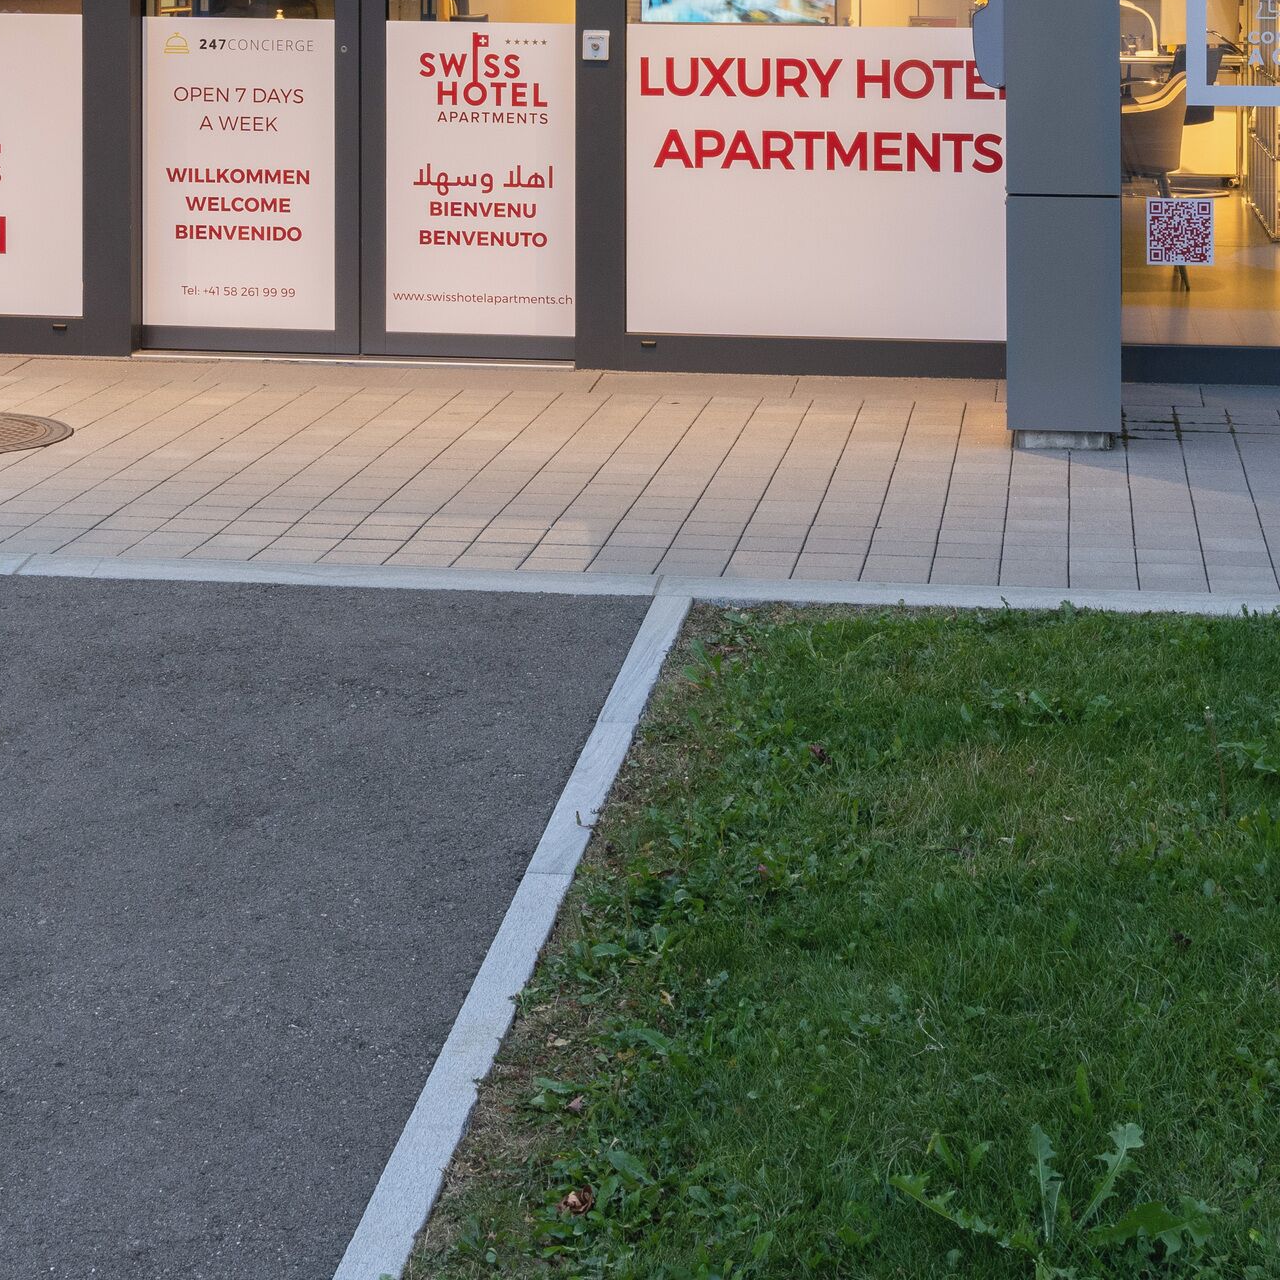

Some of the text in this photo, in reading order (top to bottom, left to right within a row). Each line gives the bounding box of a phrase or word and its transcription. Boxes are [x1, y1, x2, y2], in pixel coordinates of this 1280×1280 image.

[199, 38, 314, 52] 247CONCIERGE
[419, 32, 521, 79] SWISS
[640, 57, 843, 98] LUXURY
[173, 87, 304, 104] OPEN 7 DAYS
[437, 81, 548, 107] HOTEL
[199, 115, 278, 132] A WEEK
[437, 111, 549, 125] APARTMENTS
[653, 129, 1003, 174] APARTMENTS
[166, 167, 310, 185] WILLKOMMEN
[413, 163, 493, 196] وسهلا
[185, 196, 291, 213] WELCOME
[430, 201, 537, 218] BIENVENU
[175, 224, 302, 242] BIENVENIDO
[419, 230, 548, 248] BENVENUTO
[181, 285, 296, 298] Tel: +41 58 261 99 99
[393, 291, 573, 305] www.swisshotelapartments.ch
